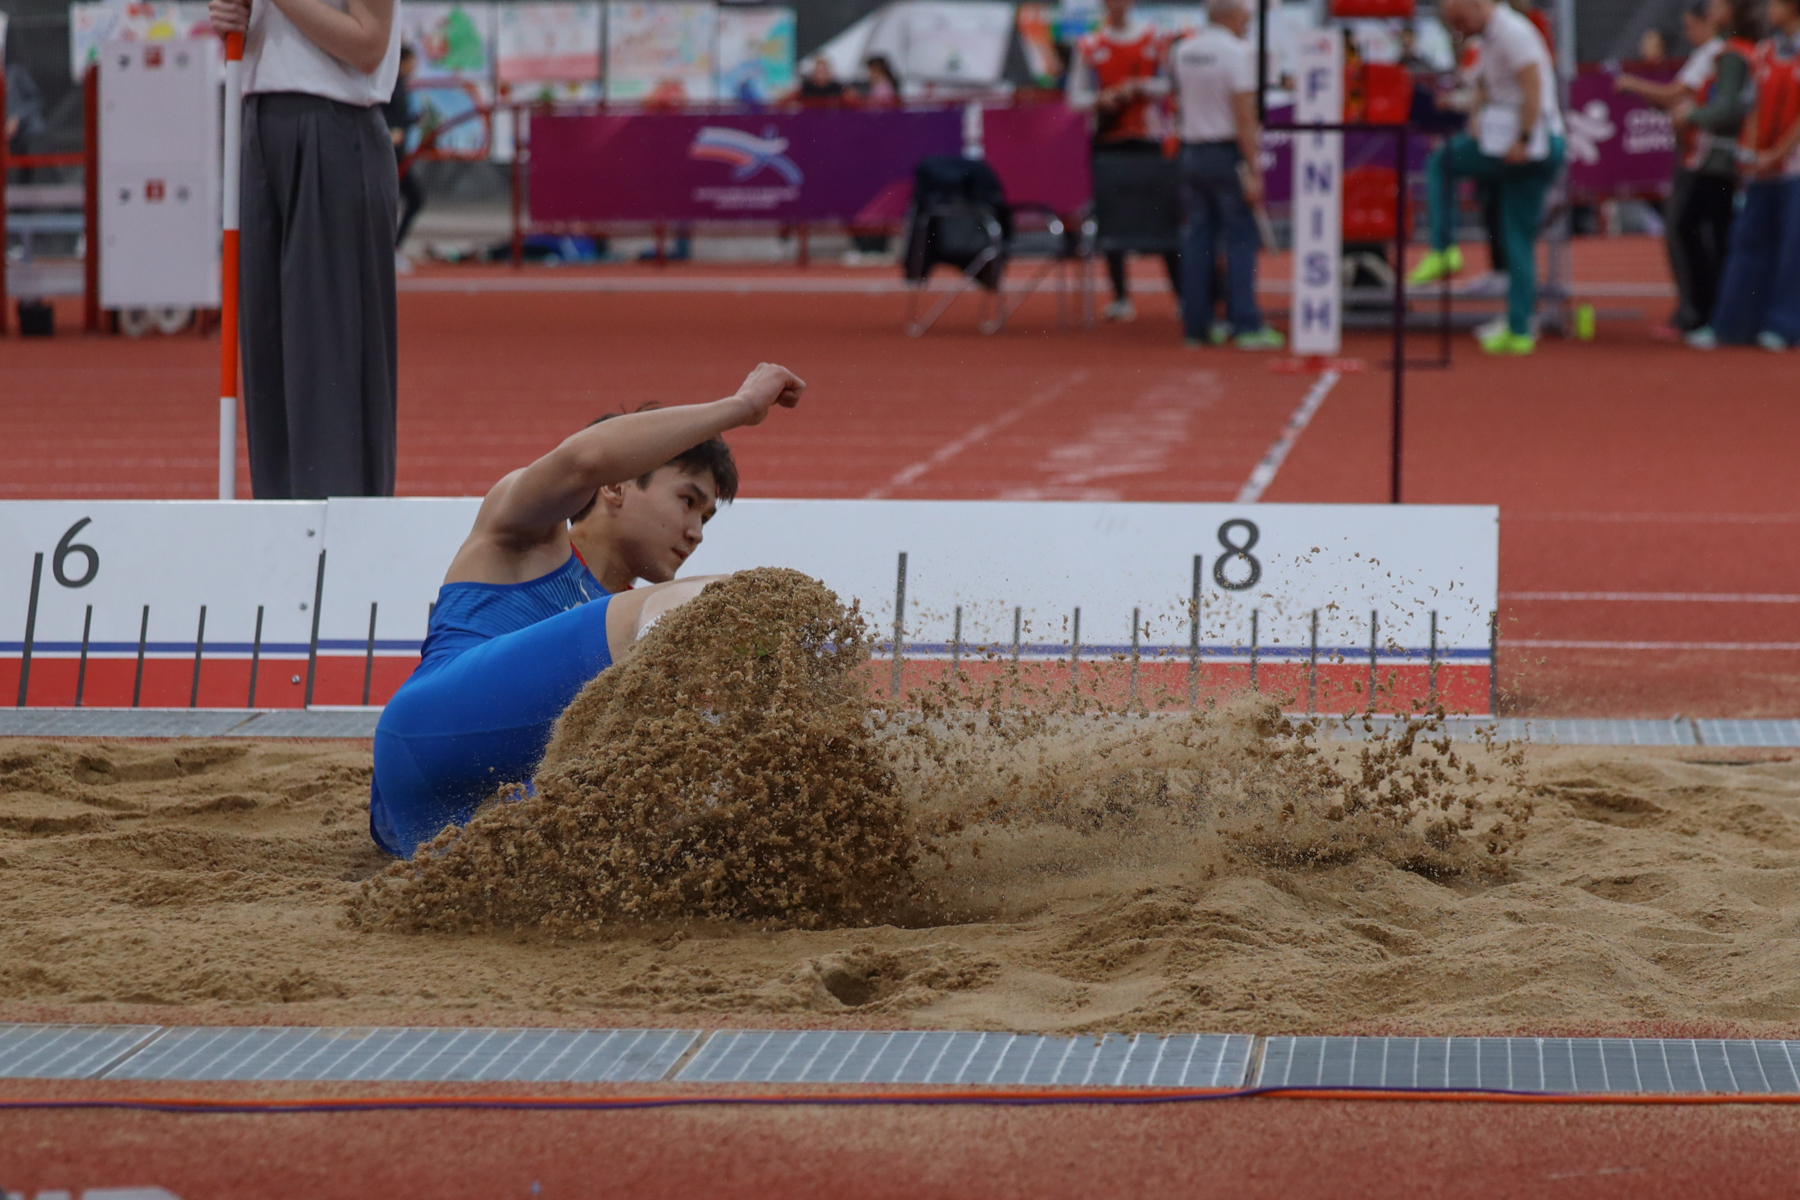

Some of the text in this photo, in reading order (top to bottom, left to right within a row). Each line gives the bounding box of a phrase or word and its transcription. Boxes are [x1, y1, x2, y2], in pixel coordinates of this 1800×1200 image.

[1302, 66, 1333, 330] FINISH
[53, 516, 99, 588] 6
[1213, 518, 1261, 590] 8
